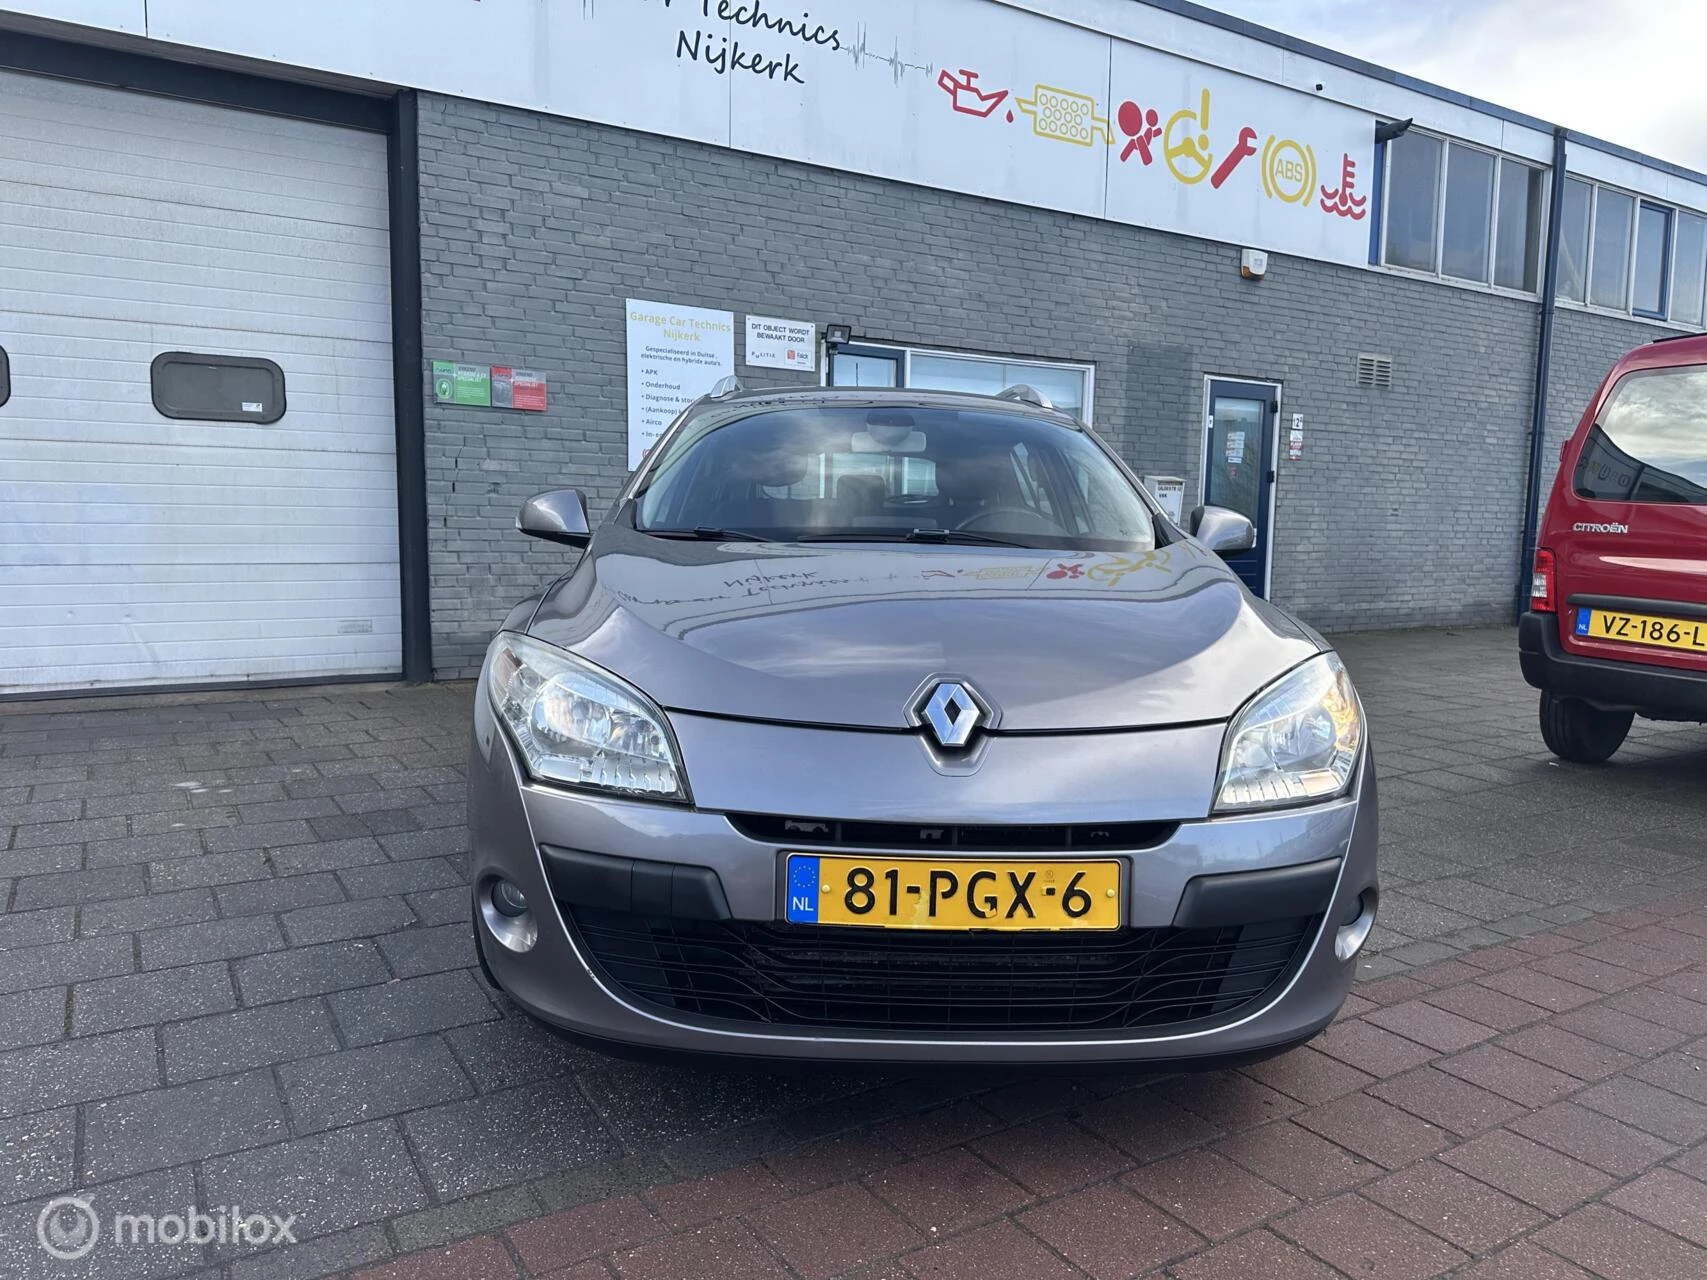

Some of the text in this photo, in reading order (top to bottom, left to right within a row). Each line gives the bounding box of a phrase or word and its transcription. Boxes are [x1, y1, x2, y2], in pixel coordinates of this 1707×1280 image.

[676, 30, 805, 84] Nijkerk
[1275, 158, 1303, 182] ABS
[630, 311, 731, 332] Garage Car Technics
[663, 328, 701, 341] Nijkerk
[751, 323, 810, 336] DIT OBJECT WORDT
[756, 332, 805, 343] BEWAAKT DOOR
[645, 345, 689, 356] Gespecialiseerd
[640, 353, 672, 362] elektrische
[681, 356, 703, 365] hybride
[645, 368, 658, 376] APK
[645, 381, 681, 390] Onderhoud
[645, 393, 674, 403] Diagnose
[645, 406, 678, 416] (Aankoop)
[1572, 522, 1629, 534] CITROËN
[1578, 623, 1588, 631] NL
[1603, 615, 1705, 647] VZ-186-L
[844, 866, 1093, 919] 81-PGX-6
[792, 892, 814, 912] NL
